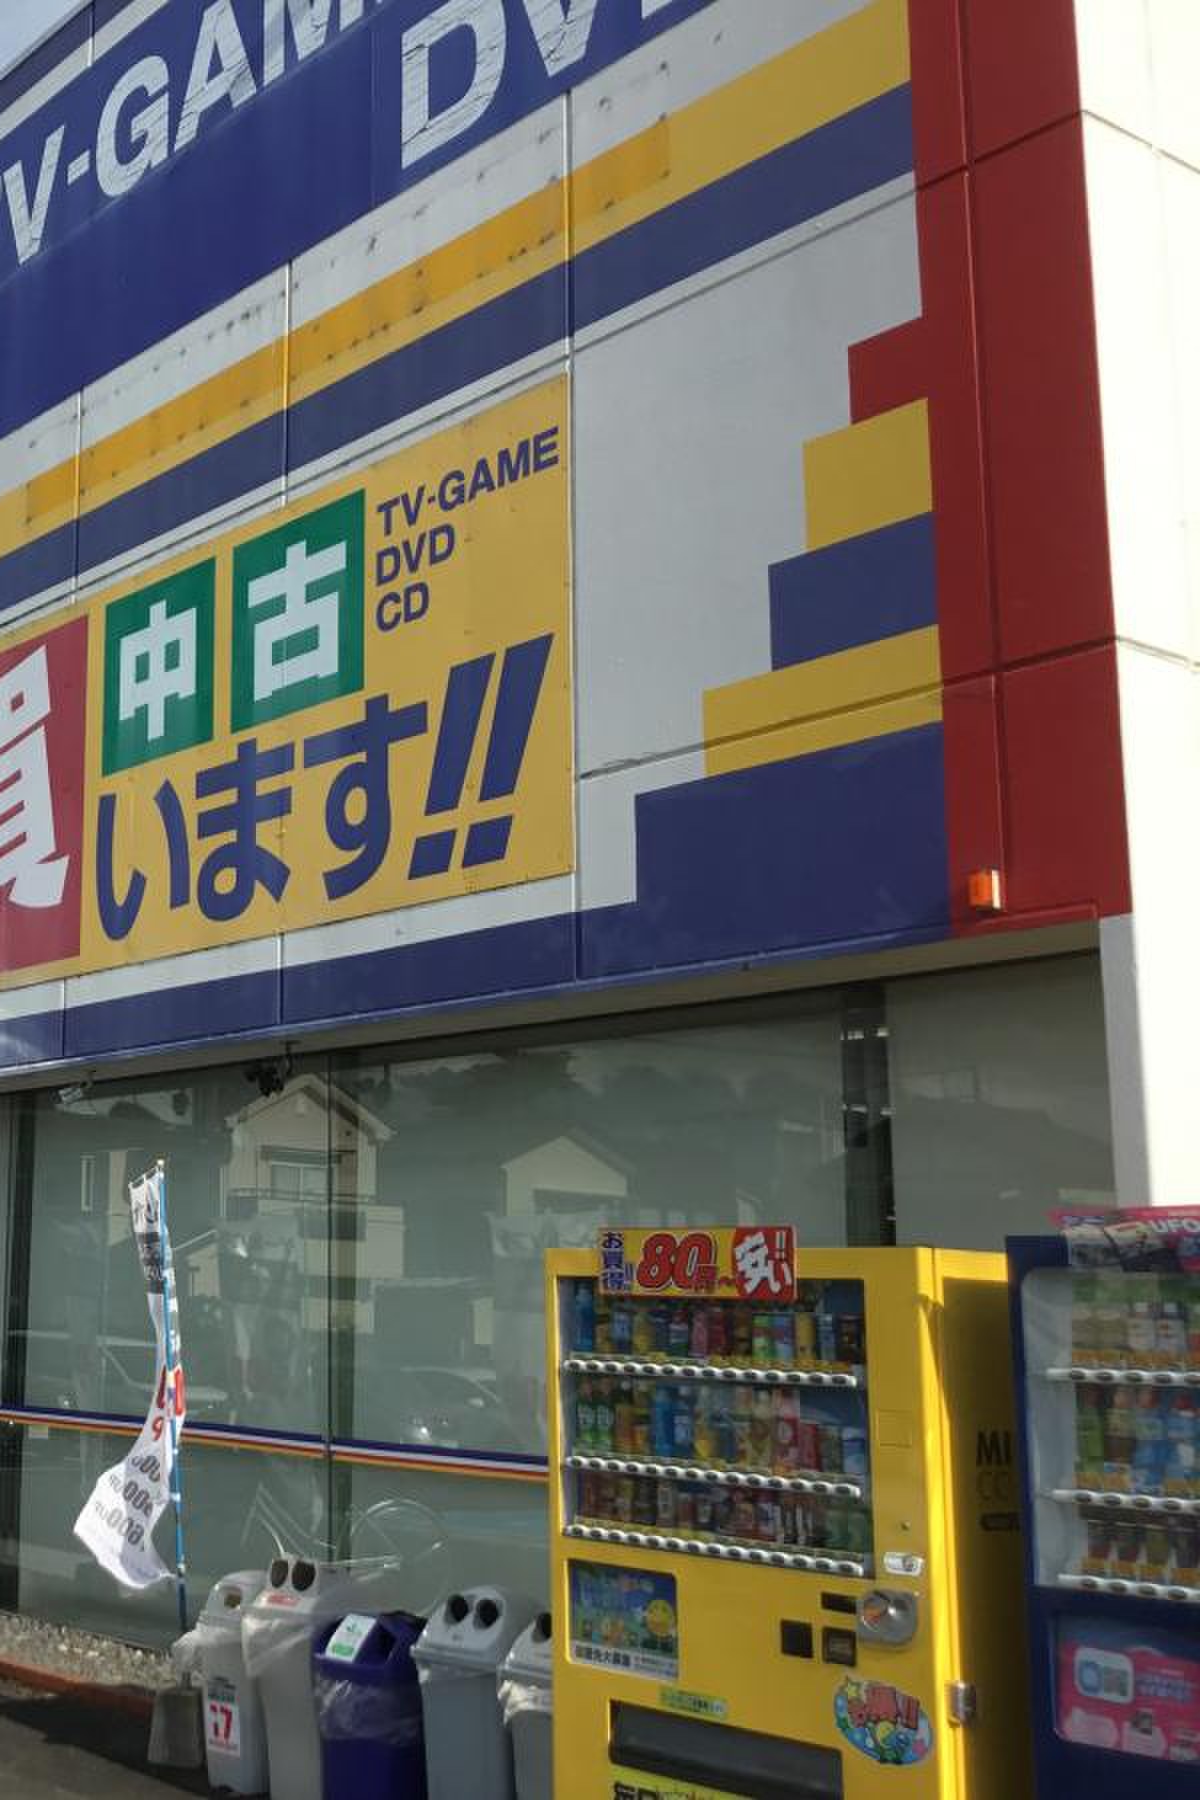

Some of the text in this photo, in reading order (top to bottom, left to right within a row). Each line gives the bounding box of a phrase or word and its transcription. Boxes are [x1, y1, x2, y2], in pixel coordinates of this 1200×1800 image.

[376, 427, 560, 537] TV-GAME
[376, 523, 455, 587] DVD
[119, 540, 347, 742] 中古
[376, 582, 429, 632] CD
